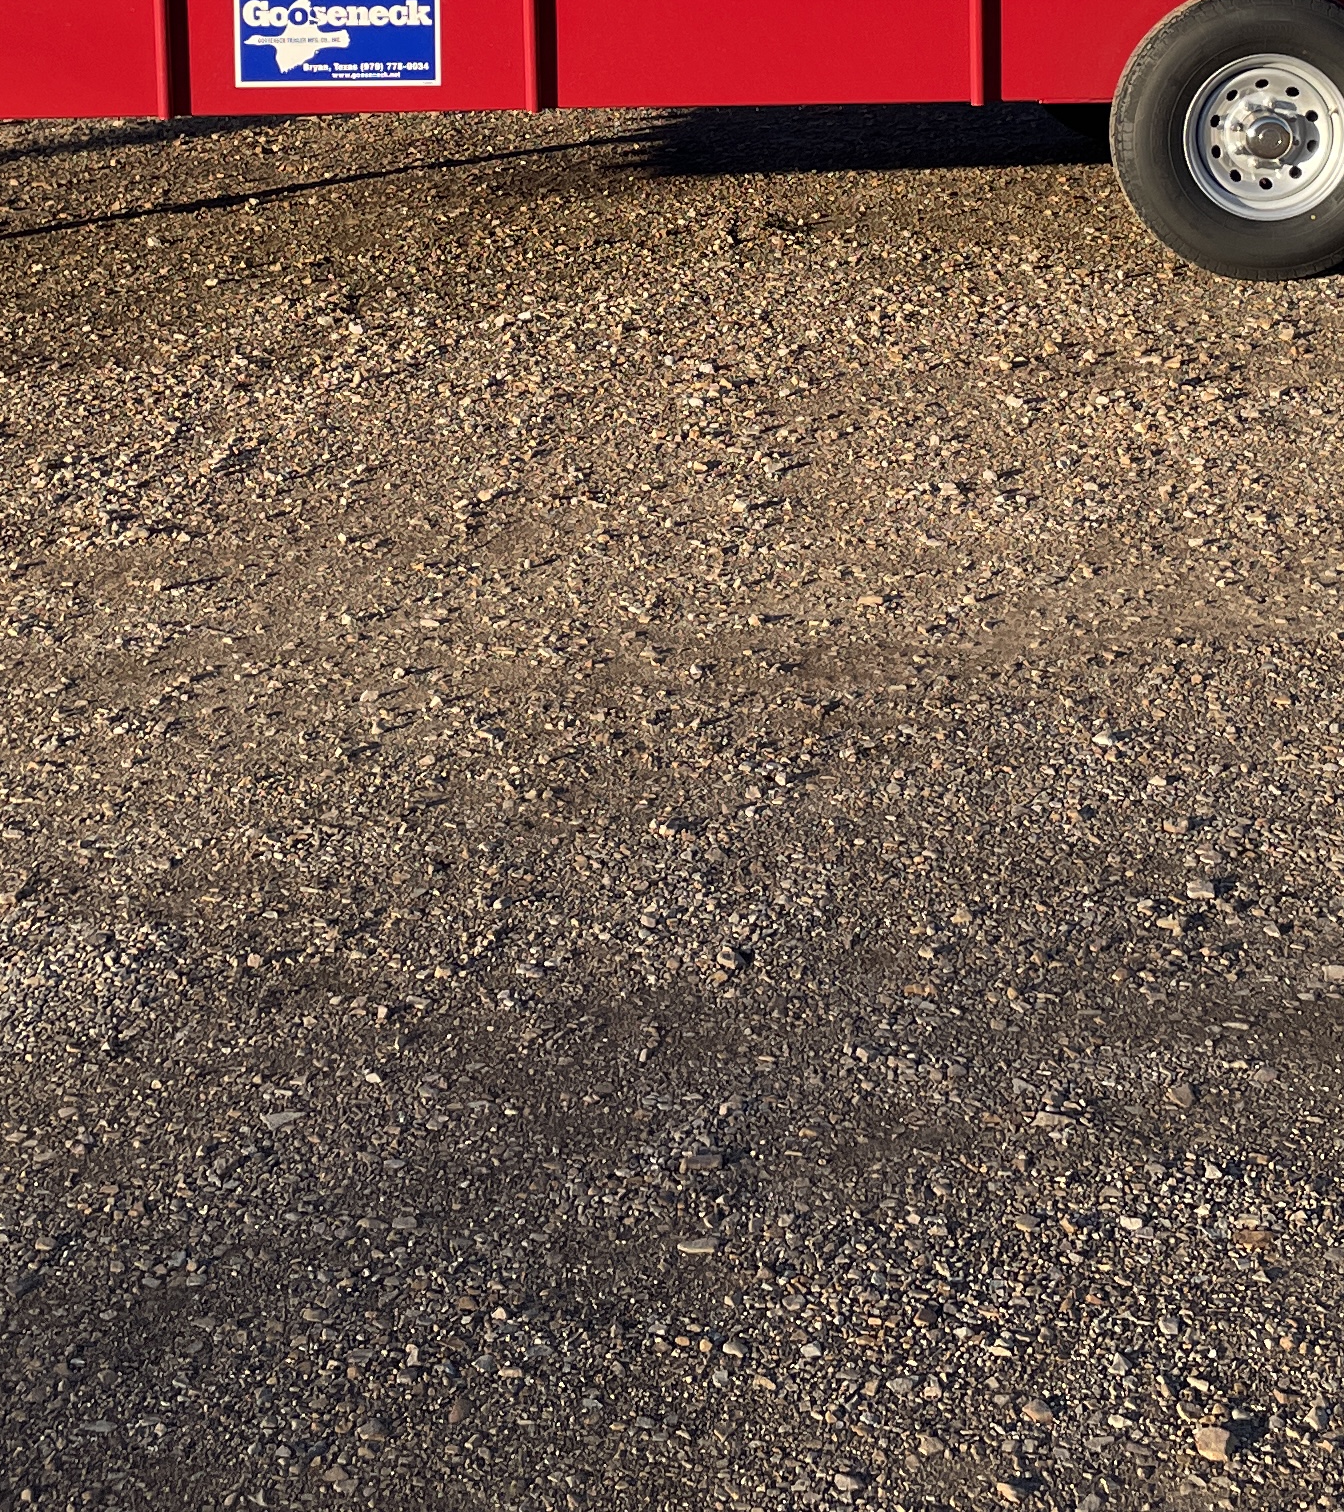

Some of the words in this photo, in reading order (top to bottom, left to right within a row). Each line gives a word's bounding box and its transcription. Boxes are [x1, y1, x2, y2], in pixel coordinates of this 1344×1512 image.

[242, 0, 433, 27] Gooseneck
[302, 63, 331, 72] Bryan,
[333, 62, 358, 71] Texas
